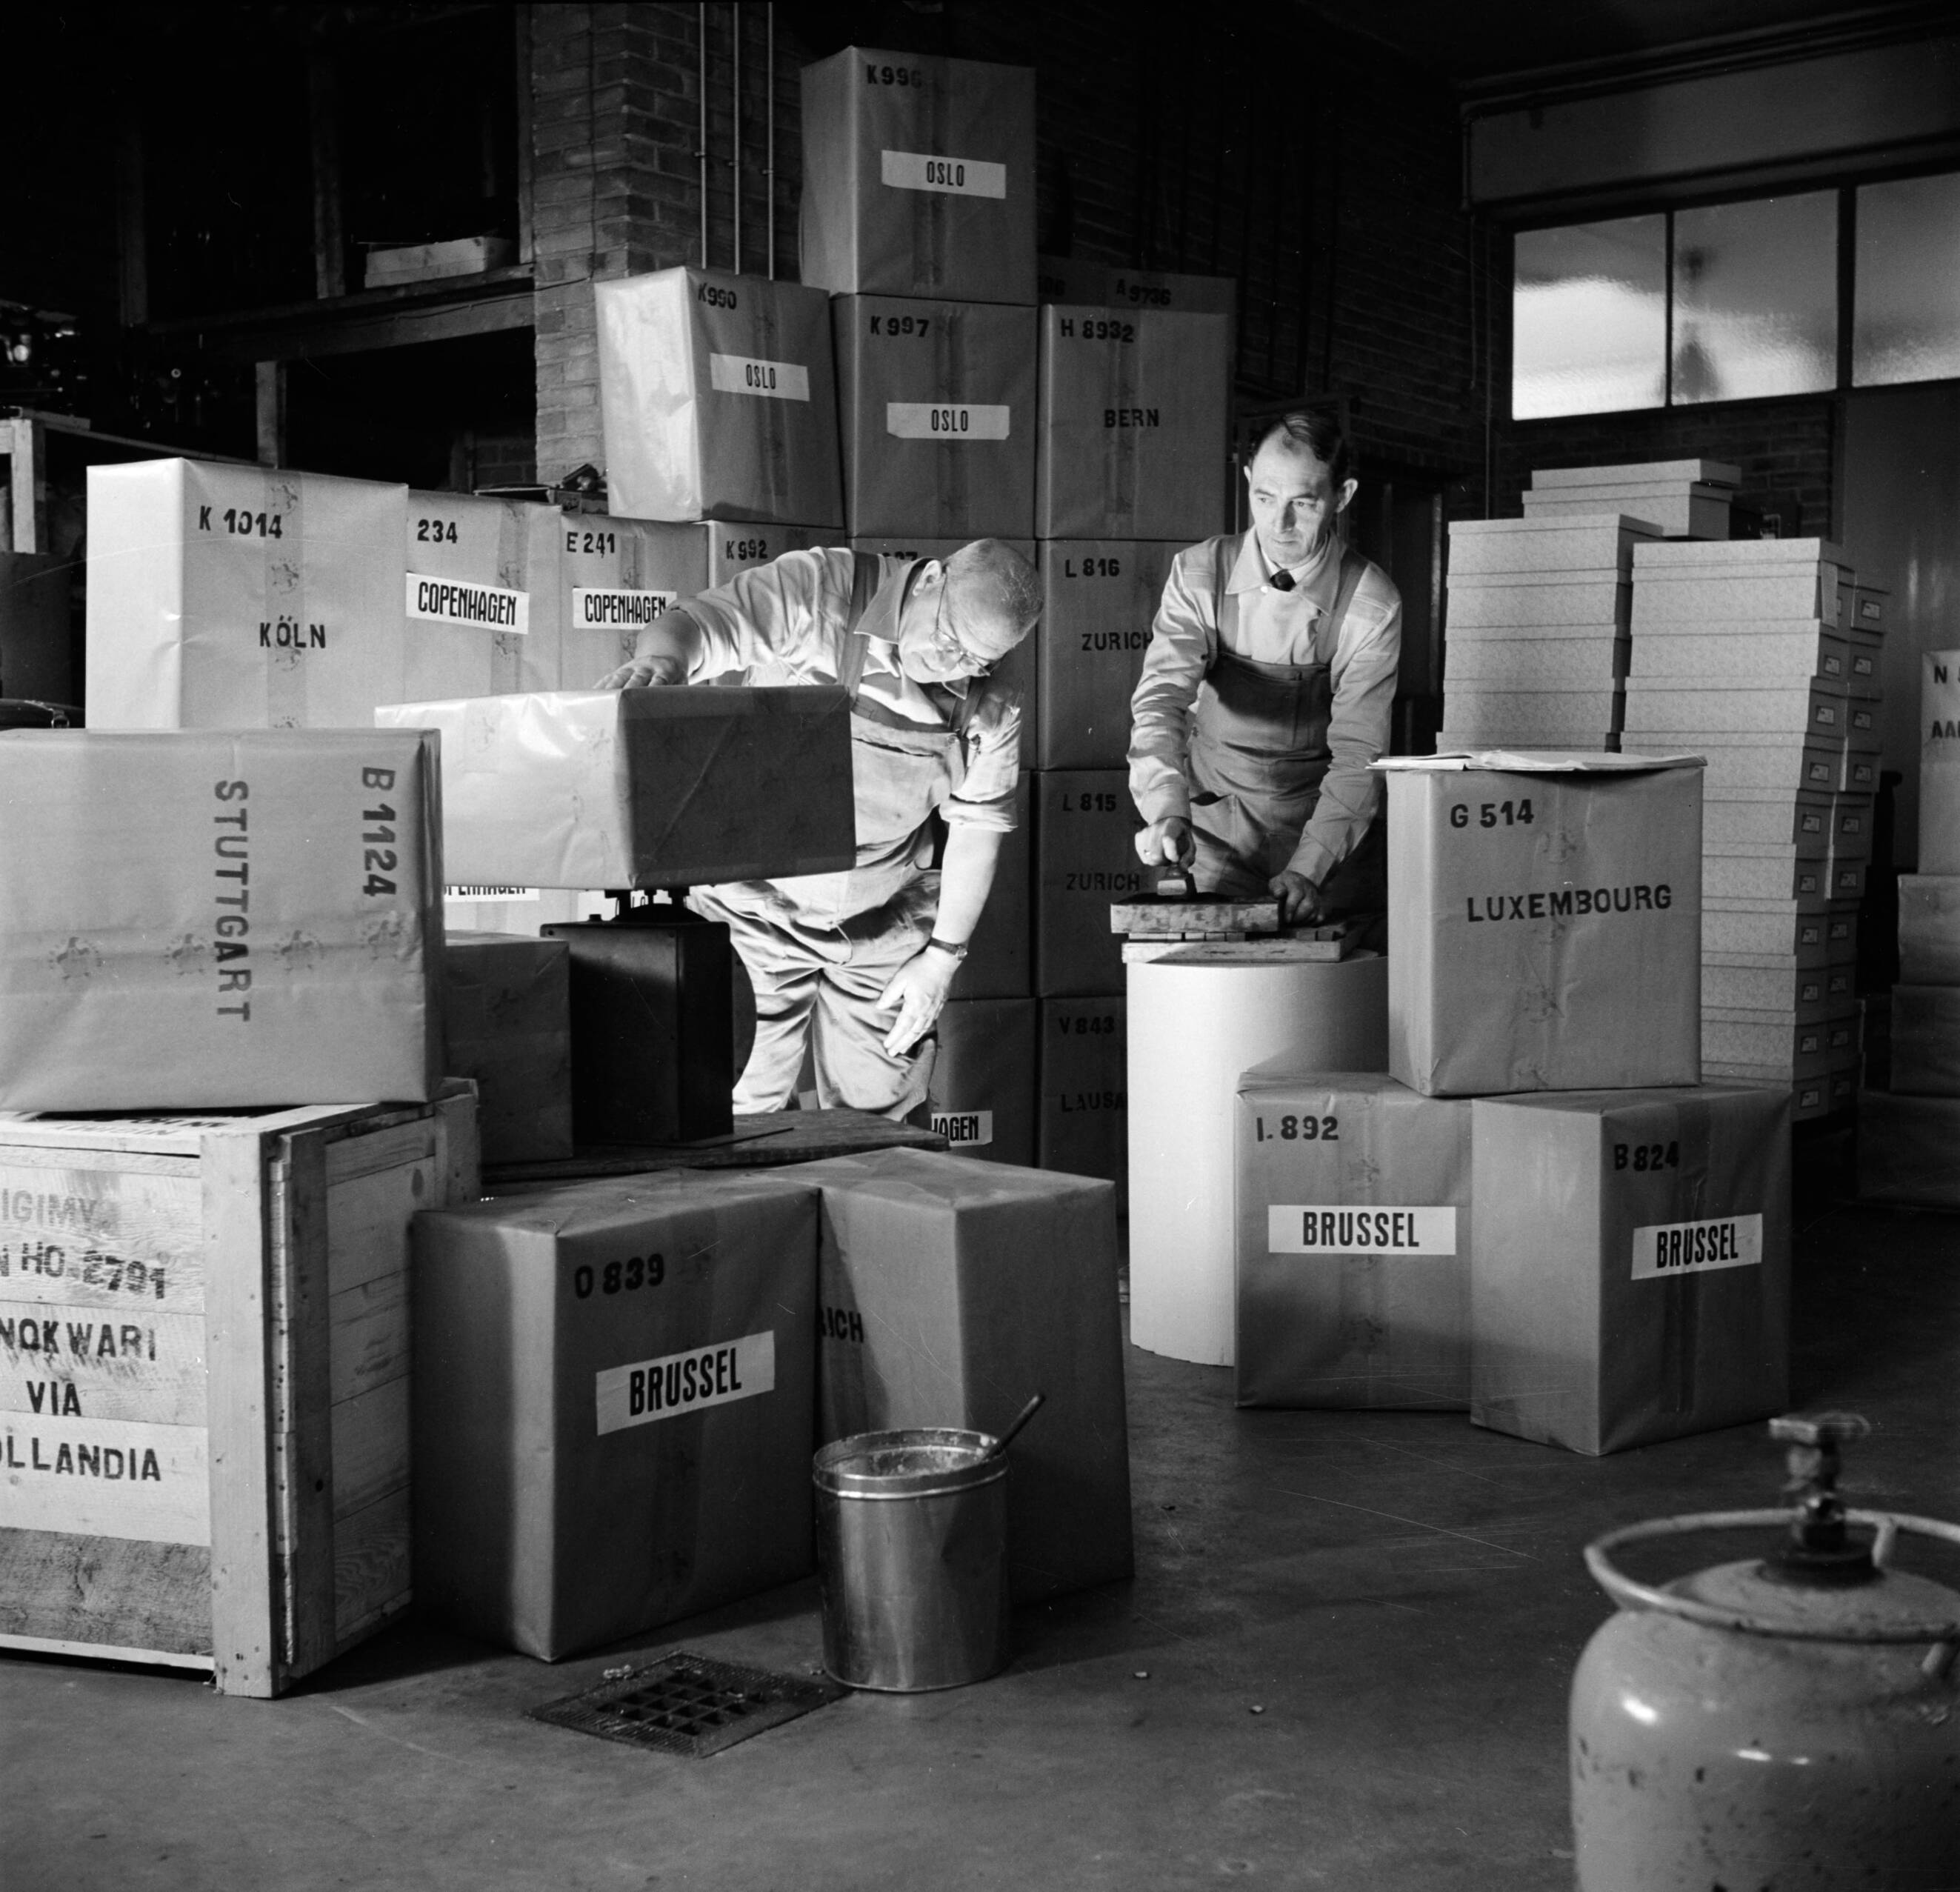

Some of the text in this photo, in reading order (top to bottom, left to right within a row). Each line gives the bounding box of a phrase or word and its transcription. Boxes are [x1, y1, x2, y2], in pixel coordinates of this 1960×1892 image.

[927, 161, 964, 186] OSLO
[1060, 318, 1134, 342] H 8932
[746, 364, 776, 390] OSLO
[931, 409, 968, 431] OSLO
[1104, 408, 1160, 428] BERN
[199, 506, 283, 539] K 1014
[416, 519, 459, 544] 234
[567, 531, 616, 559] E 241
[1064, 557, 1120, 579] L 816
[417, 582, 517, 626] COPENHAGEN
[259, 613, 327, 649] KÖLN
[1932, 720, 1960, 739] AA
[1061, 793, 1117, 812] L 815
[1450, 799, 1534, 828] G 514
[362, 767, 398, 897] B 1124
[1066, 873, 1140, 891] ZURICH
[213, 780, 253, 1022] STUTTGART
[1467, 885, 1673, 922] LUXEMBOURG
[1280, 1115, 1339, 1140] 892
[1303, 1212, 1420, 1248] BRUSSEL
[1657, 1224, 1738, 1268] BRUSSEL
[602, 1253, 664, 1295] 839
[630, 1348, 741, 1416] BRUSSEL
[26, 1380, 81, 1416] VIA
[0, 1435, 161, 1482] LLANDIA
